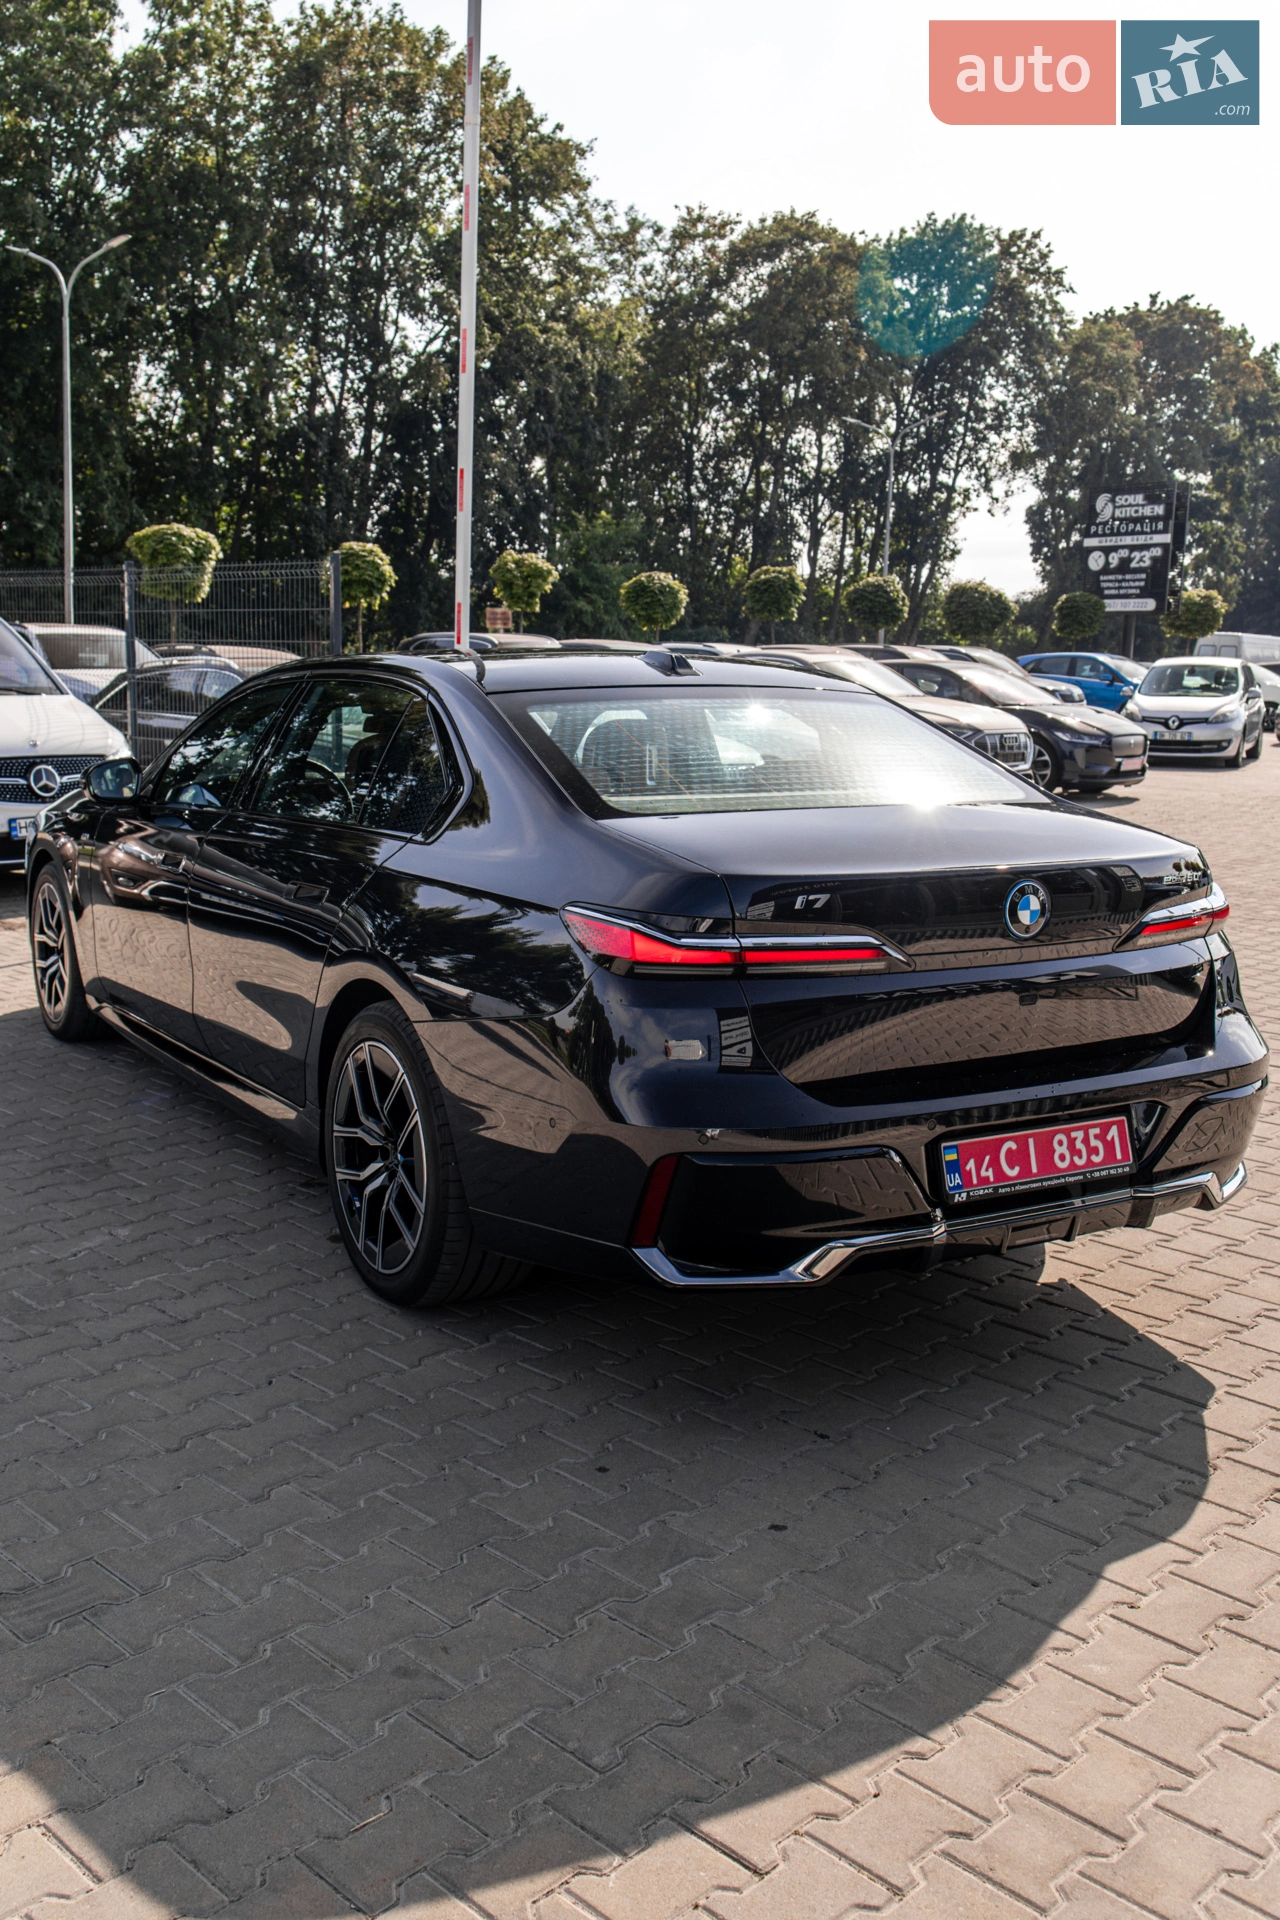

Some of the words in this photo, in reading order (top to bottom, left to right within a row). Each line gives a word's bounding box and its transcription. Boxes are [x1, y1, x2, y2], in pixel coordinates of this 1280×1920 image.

[1114, 494, 1147, 505] SOUL
[1114, 504, 1165, 518] KITCHEN
[1090, 521, 1164, 535] РЕСТОРАЦІЯ
[794, 892, 832, 910] i7
[1012, 885, 1047, 904] BMW
[965, 1154, 994, 1185] 14
[1052, 1124, 1123, 1169] 8351
[947, 1172, 962, 1188] UA
[969, 1187, 994, 1197] KOZAK
